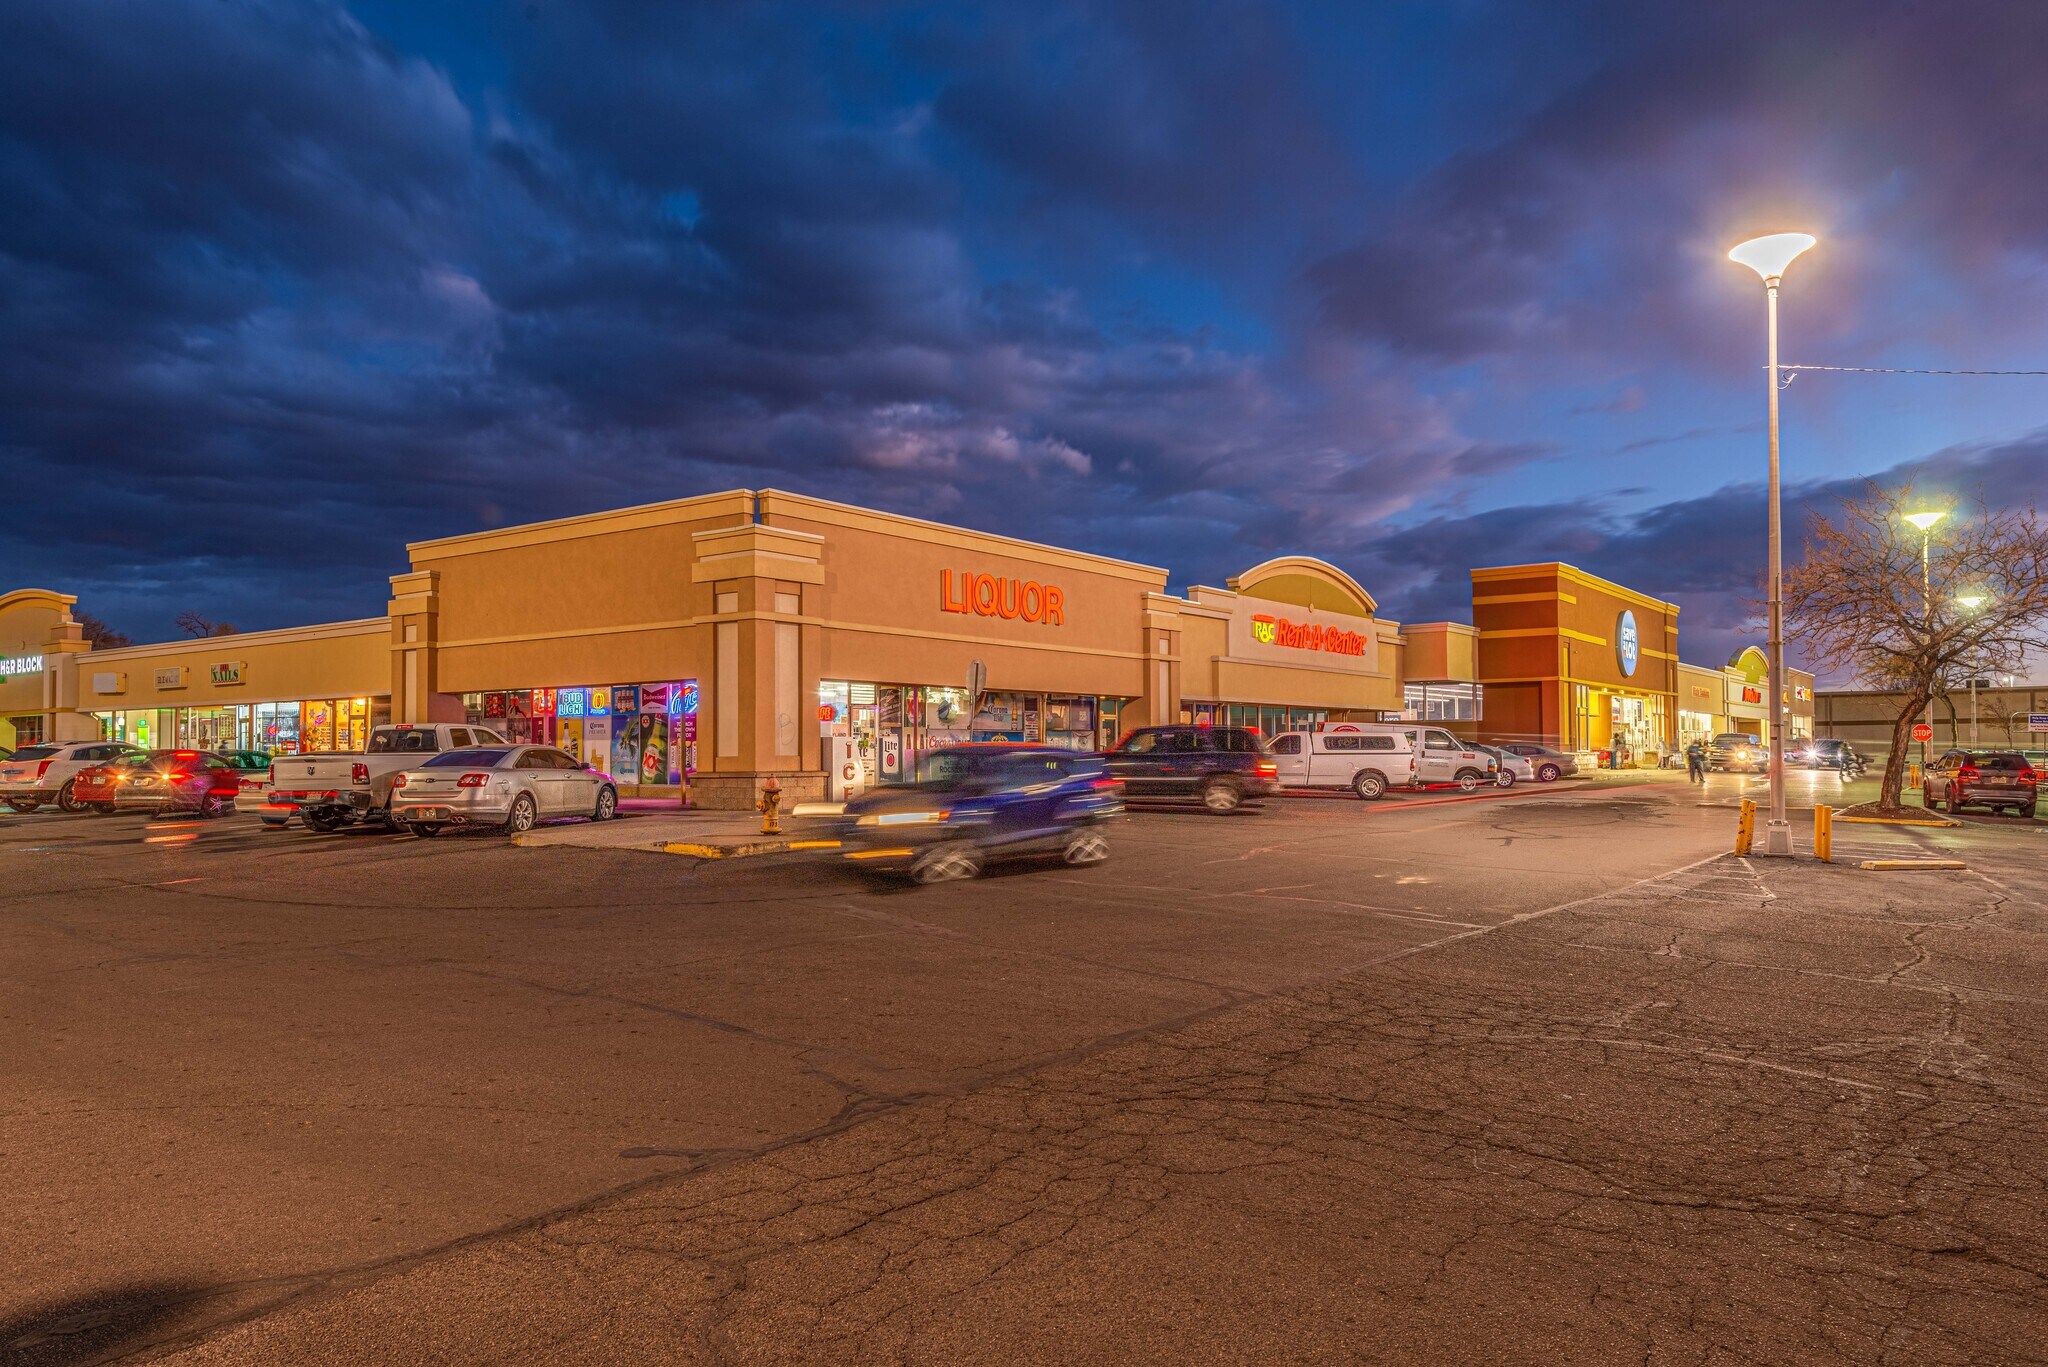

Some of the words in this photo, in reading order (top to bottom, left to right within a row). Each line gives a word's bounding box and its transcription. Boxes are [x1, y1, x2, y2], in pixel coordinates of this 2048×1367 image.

[941, 569, 1064, 626] LIQUOR
[1254, 621, 1275, 643] RAC
[0, 659, 16, 675] H&R
[17, 655, 43, 674] BLOCK
[563, 692, 583, 704] BUD
[988, 704, 1008, 714] Corona
[589, 722, 605, 730] Corona
[1913, 729, 1932, 737] STOP
[884, 740, 898, 753] Lite
[842, 741, 855, 801] ICE
